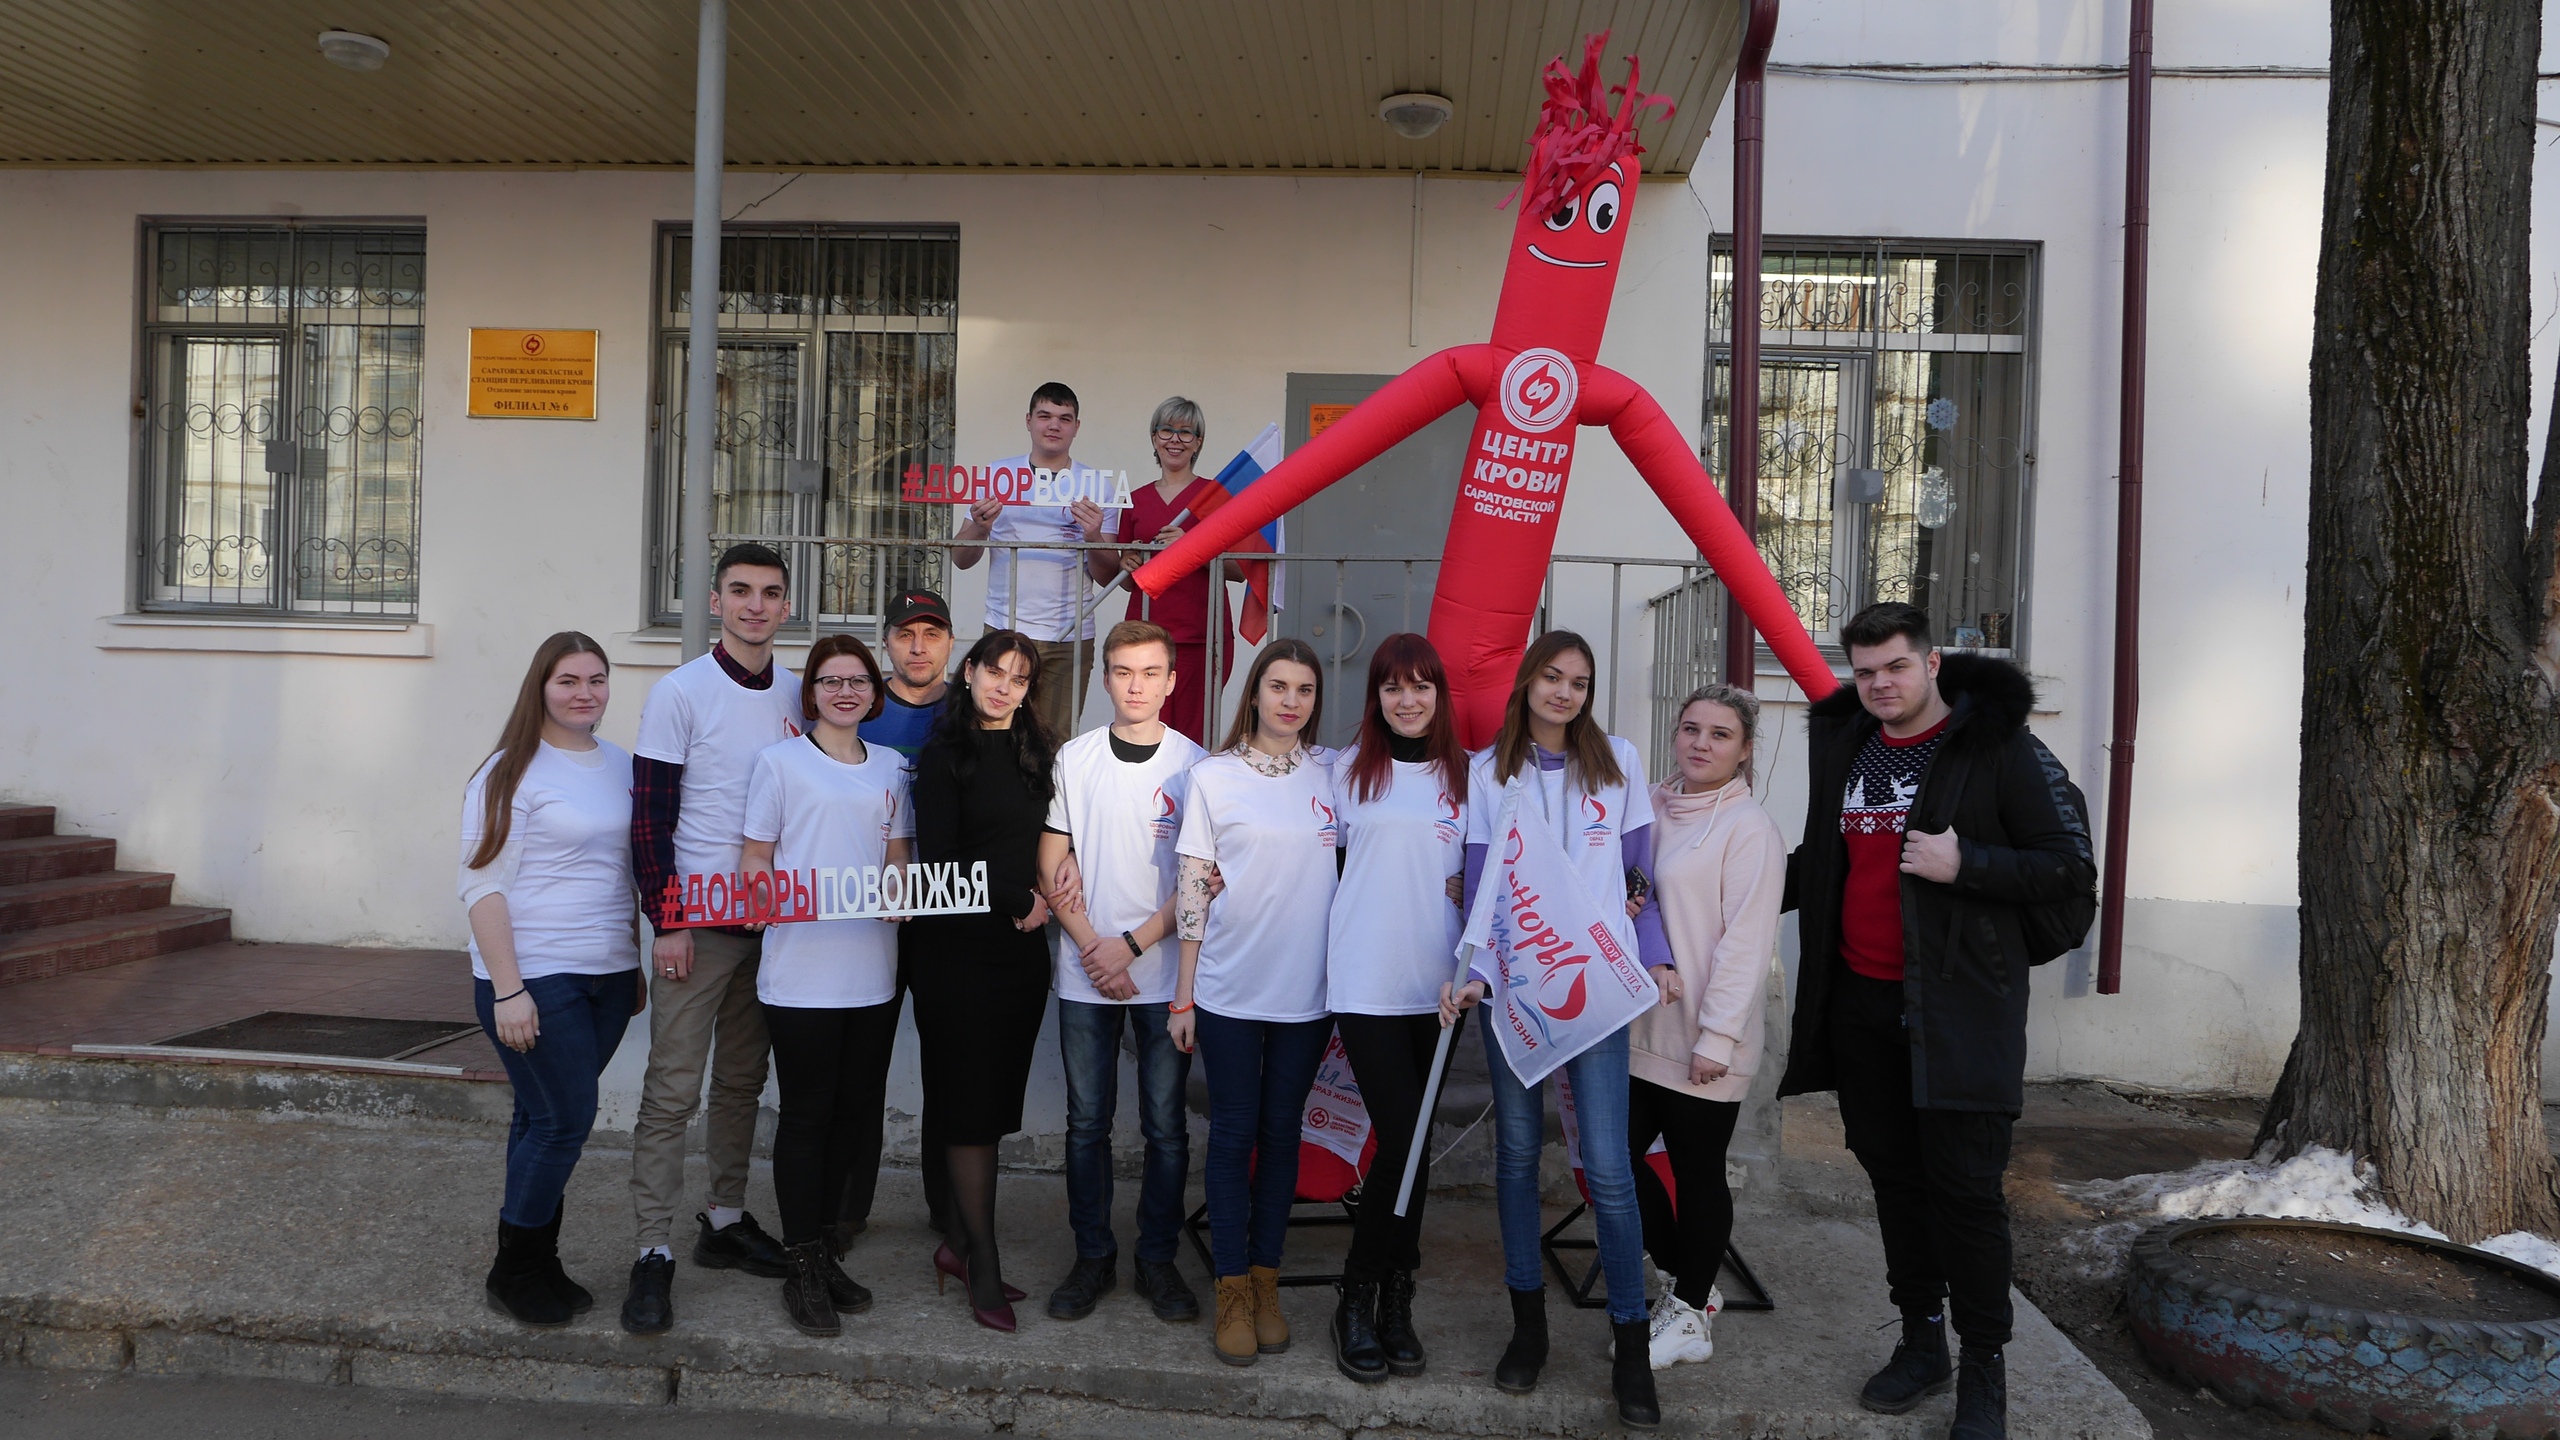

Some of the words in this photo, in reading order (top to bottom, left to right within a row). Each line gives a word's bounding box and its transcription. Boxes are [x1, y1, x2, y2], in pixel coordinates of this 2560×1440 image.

[471, 376, 508, 384] СТАНЦИЯ
[509, 377, 566, 385] ПЕРЕЛИВАНИЯ
[481, 367, 536, 375] САРАТОВСКАЯ
[536, 368, 584, 376] ОБЛАСТНАЯ
[494, 401, 546, 411] ФИЛИАЛ
[562, 402, 569, 411] 6
[1481, 429, 1569, 465] ЦЕНТР
[1473, 458, 1562, 494] КРОВИ
[1464, 484, 1555, 513] САРАТОВСКОЙ
[1474, 501, 1541, 524] ОБЛАСТИ
[1590, 924, 1620, 959] ДОНОР
[1615, 959, 1642, 993] ВОЛГА
[1311, 1083, 1333, 1096] БРАЗ
[1333, 1092, 1362, 1107] ЖИЗНИ
